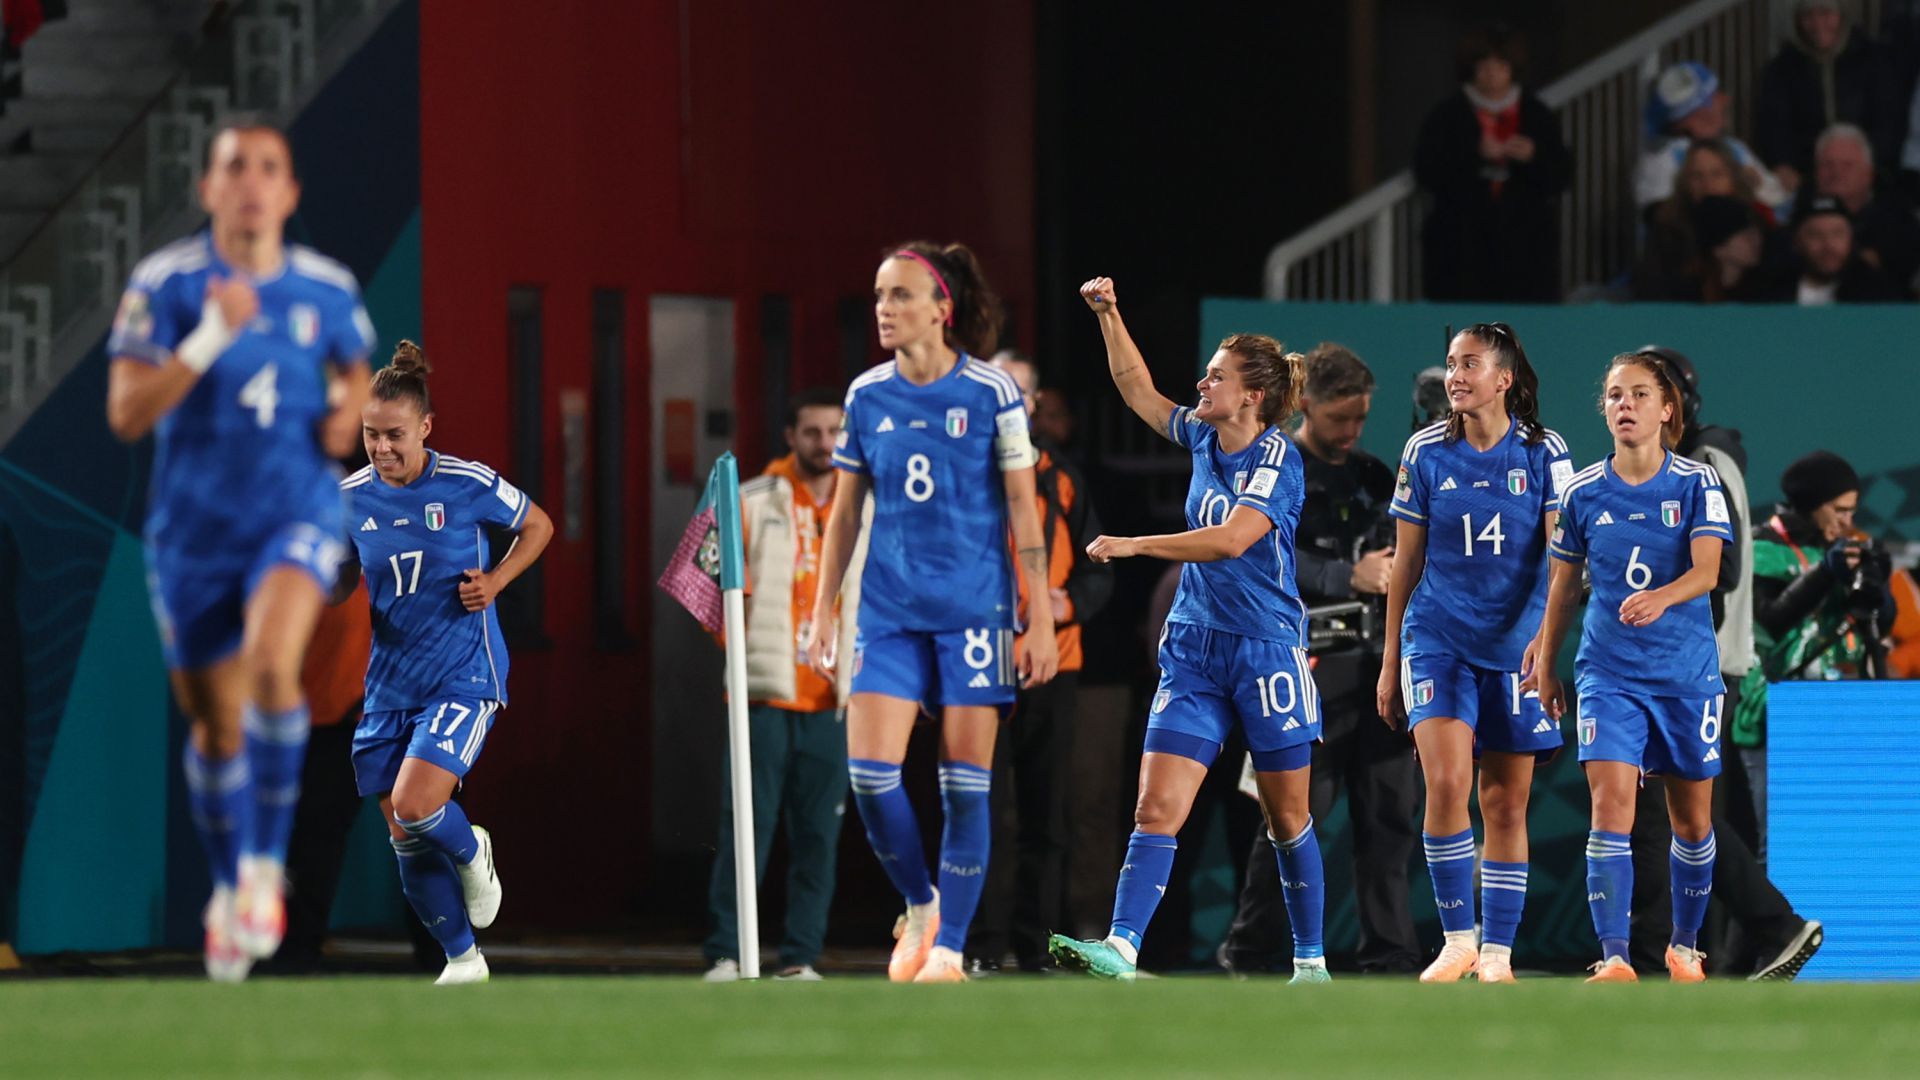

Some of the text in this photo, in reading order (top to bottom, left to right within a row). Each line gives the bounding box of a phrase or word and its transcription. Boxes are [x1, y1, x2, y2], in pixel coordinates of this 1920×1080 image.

[240, 362, 281, 429] 4
[904, 453, 935, 502] 8
[1198, 488, 1230, 527] 10
[1462, 511, 1506, 556] 14
[389, 550, 423, 597] 17
[1625, 546, 1652, 590] 6
[963, 628, 993, 669] 8
[1256, 671, 1297, 717] 10
[429, 702, 471, 736] 17
[1700, 700, 1719, 744] 6
